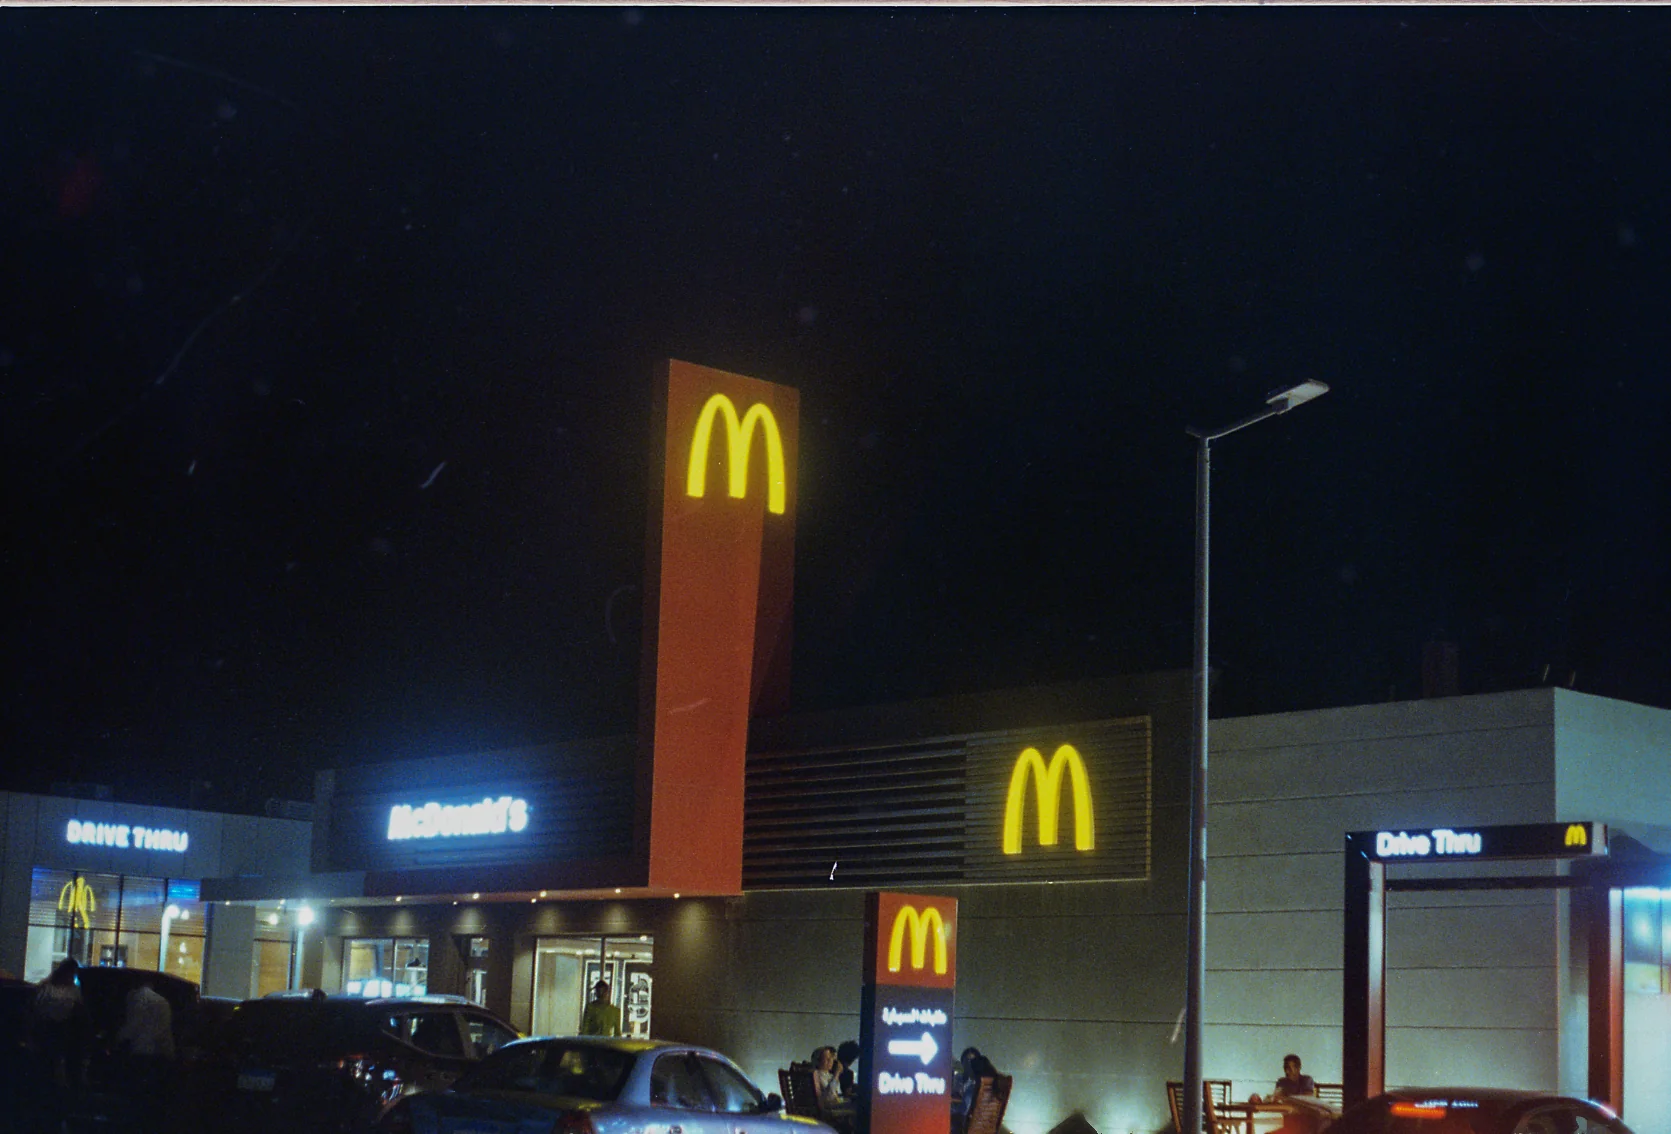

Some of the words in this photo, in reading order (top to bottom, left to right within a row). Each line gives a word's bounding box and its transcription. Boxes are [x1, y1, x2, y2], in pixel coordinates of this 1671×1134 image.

[387, 796, 528, 840] McDonald's
[66, 819, 130, 848] DRIVE
[132, 826, 189, 852] THRU
[1376, 831, 1430, 857] Drive
[1432, 829, 1482, 854] Thru
[878, 1072, 914, 1094] Drive
[914, 1072, 946, 1094] Thru
